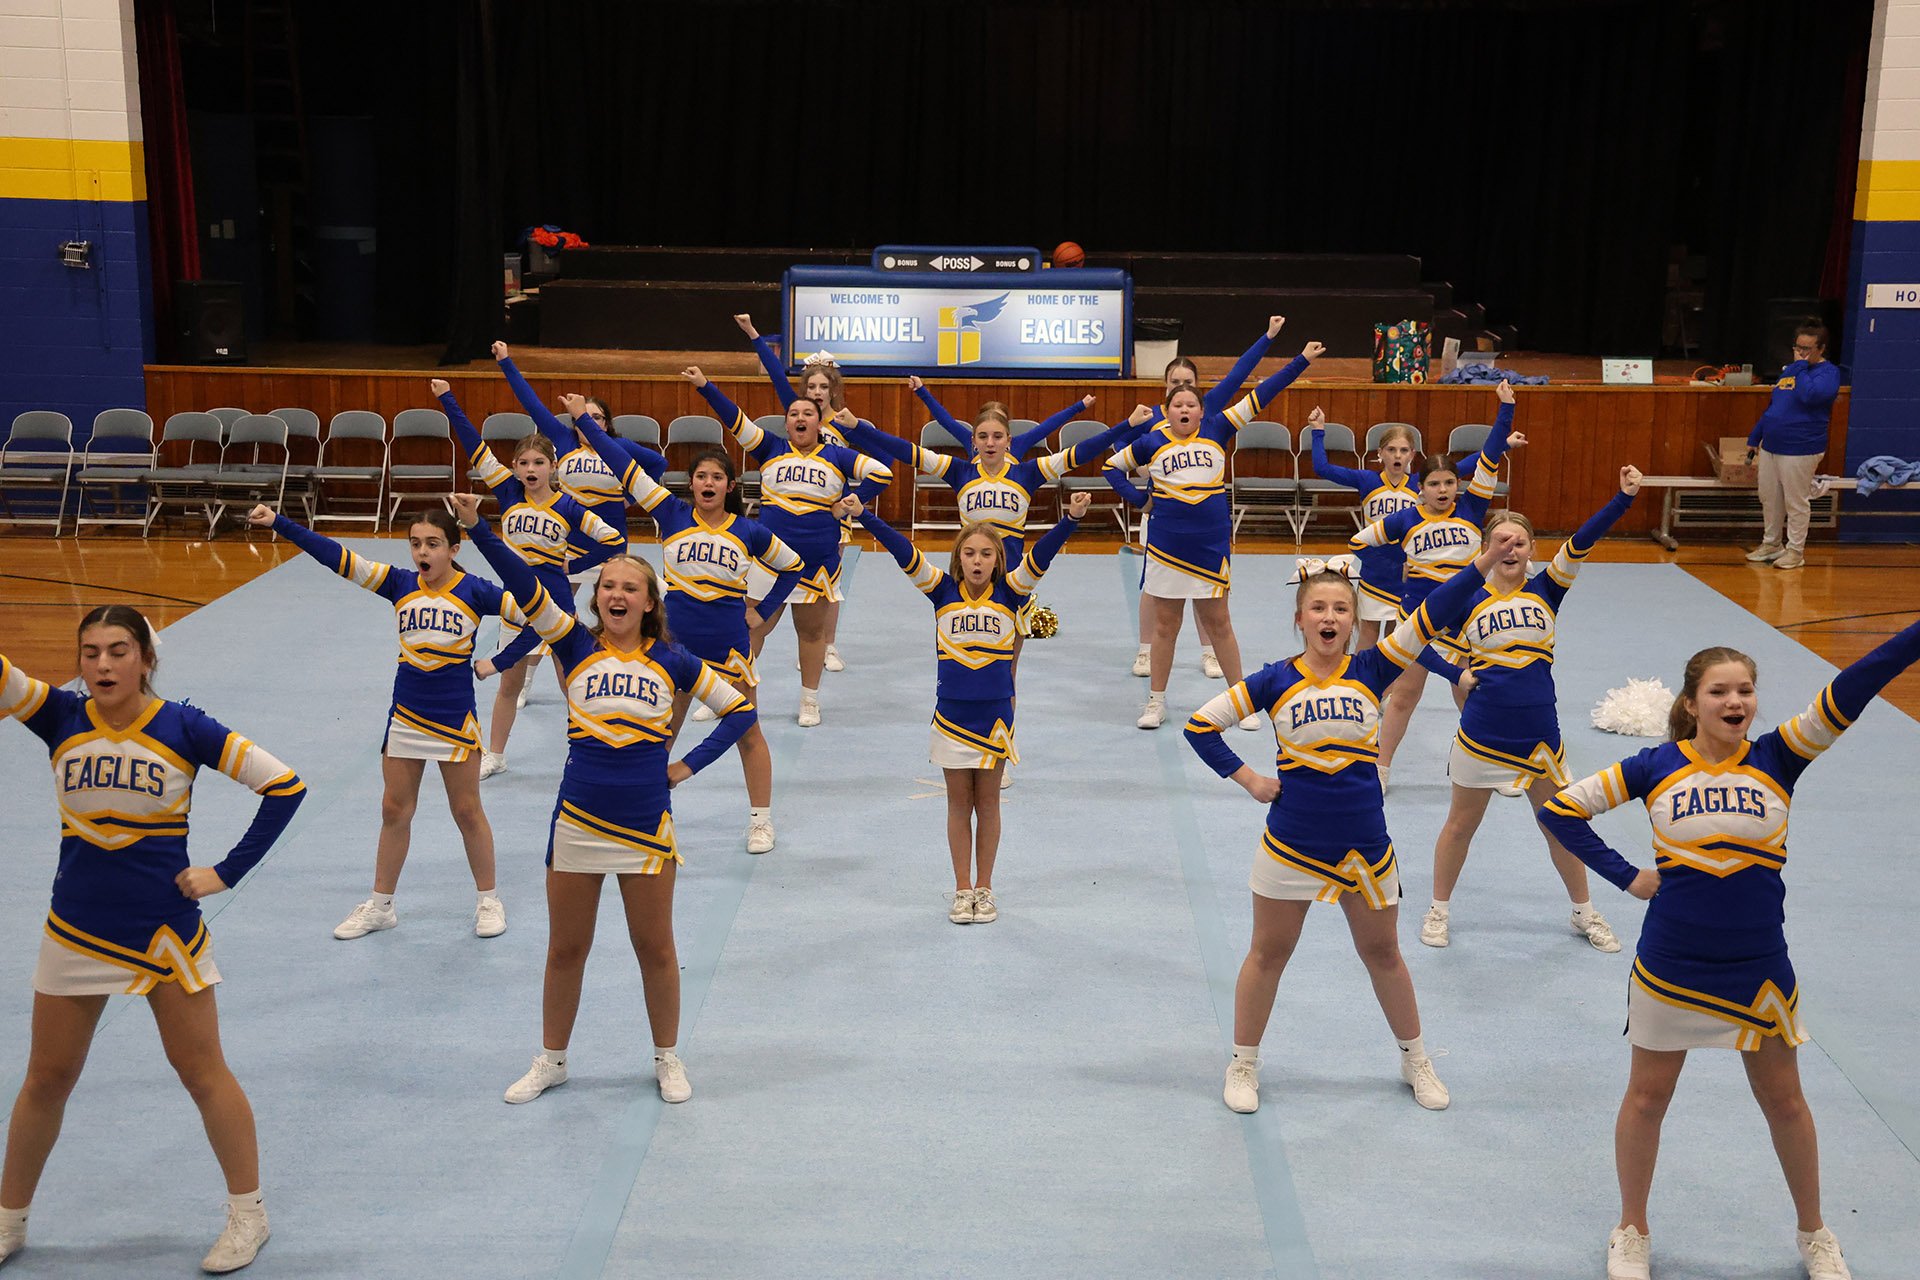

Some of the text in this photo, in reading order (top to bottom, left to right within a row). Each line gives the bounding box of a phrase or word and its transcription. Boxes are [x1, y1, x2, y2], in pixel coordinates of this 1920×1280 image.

[897, 259, 918, 267] BONUS
[943, 257, 971, 270] POSS
[995, 260, 1016, 268] BONUS
[830, 293, 900, 305] WELCOME TO
[1027, 294, 1099, 306] HOME OF THE
[1895, 290, 1920, 303] HO
[804, 315, 926, 342] IMMANUEL
[1020, 318, 1105, 345] EAGLES
[776, 465, 827, 488] EAGLES
[1162, 450, 1213, 476] EAGLES
[966, 490, 1019, 512] EAGLES
[507, 515, 562, 542] EAGLES
[1413, 527, 1470, 555] EAGLES
[676, 542, 739, 572] EAGLES
[399, 607, 464, 637] EAGLES
[951, 614, 1001, 635] EAGLES
[1477, 606, 1547, 641] EAGLES
[585, 673, 660, 707] EAGLES
[1290, 696, 1365, 731] EAGLES
[63, 755, 167, 799] EAGLES
[1670, 786, 1767, 824] EAGLES
